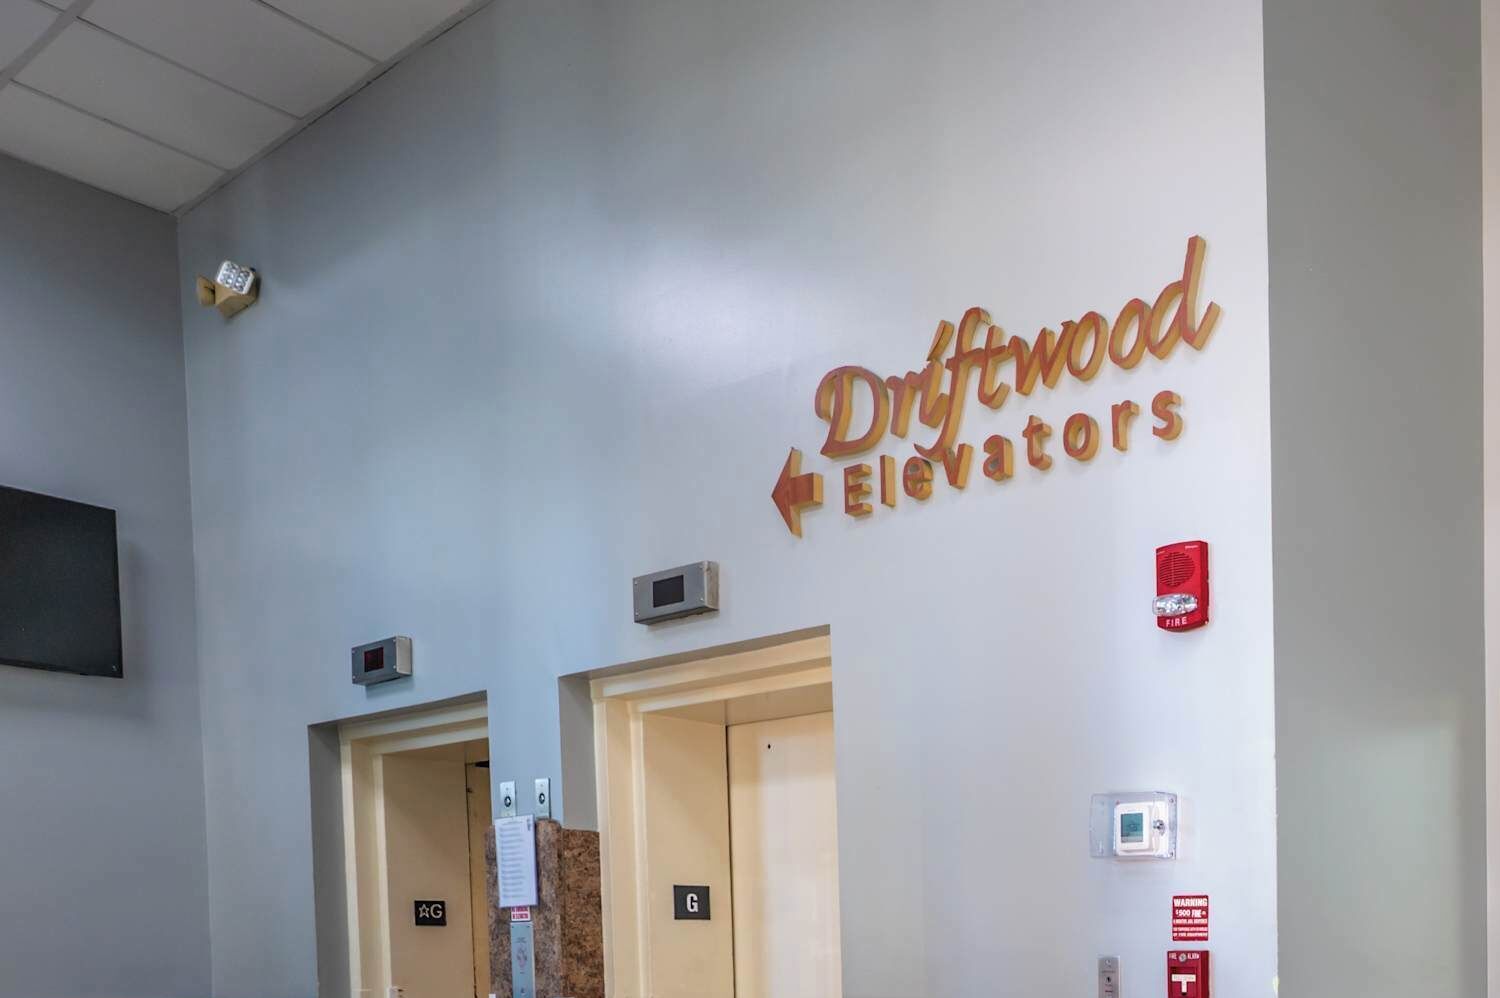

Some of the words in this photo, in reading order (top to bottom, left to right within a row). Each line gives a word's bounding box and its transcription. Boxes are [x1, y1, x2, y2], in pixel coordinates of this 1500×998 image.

[814, 234, 1221, 462] Driftwood
[843, 389, 1183, 518] Elevators
[1165, 617, 1188, 627] FIRE
[686, 893, 699, 912] G
[1173, 898, 1208, 907] WARNING
